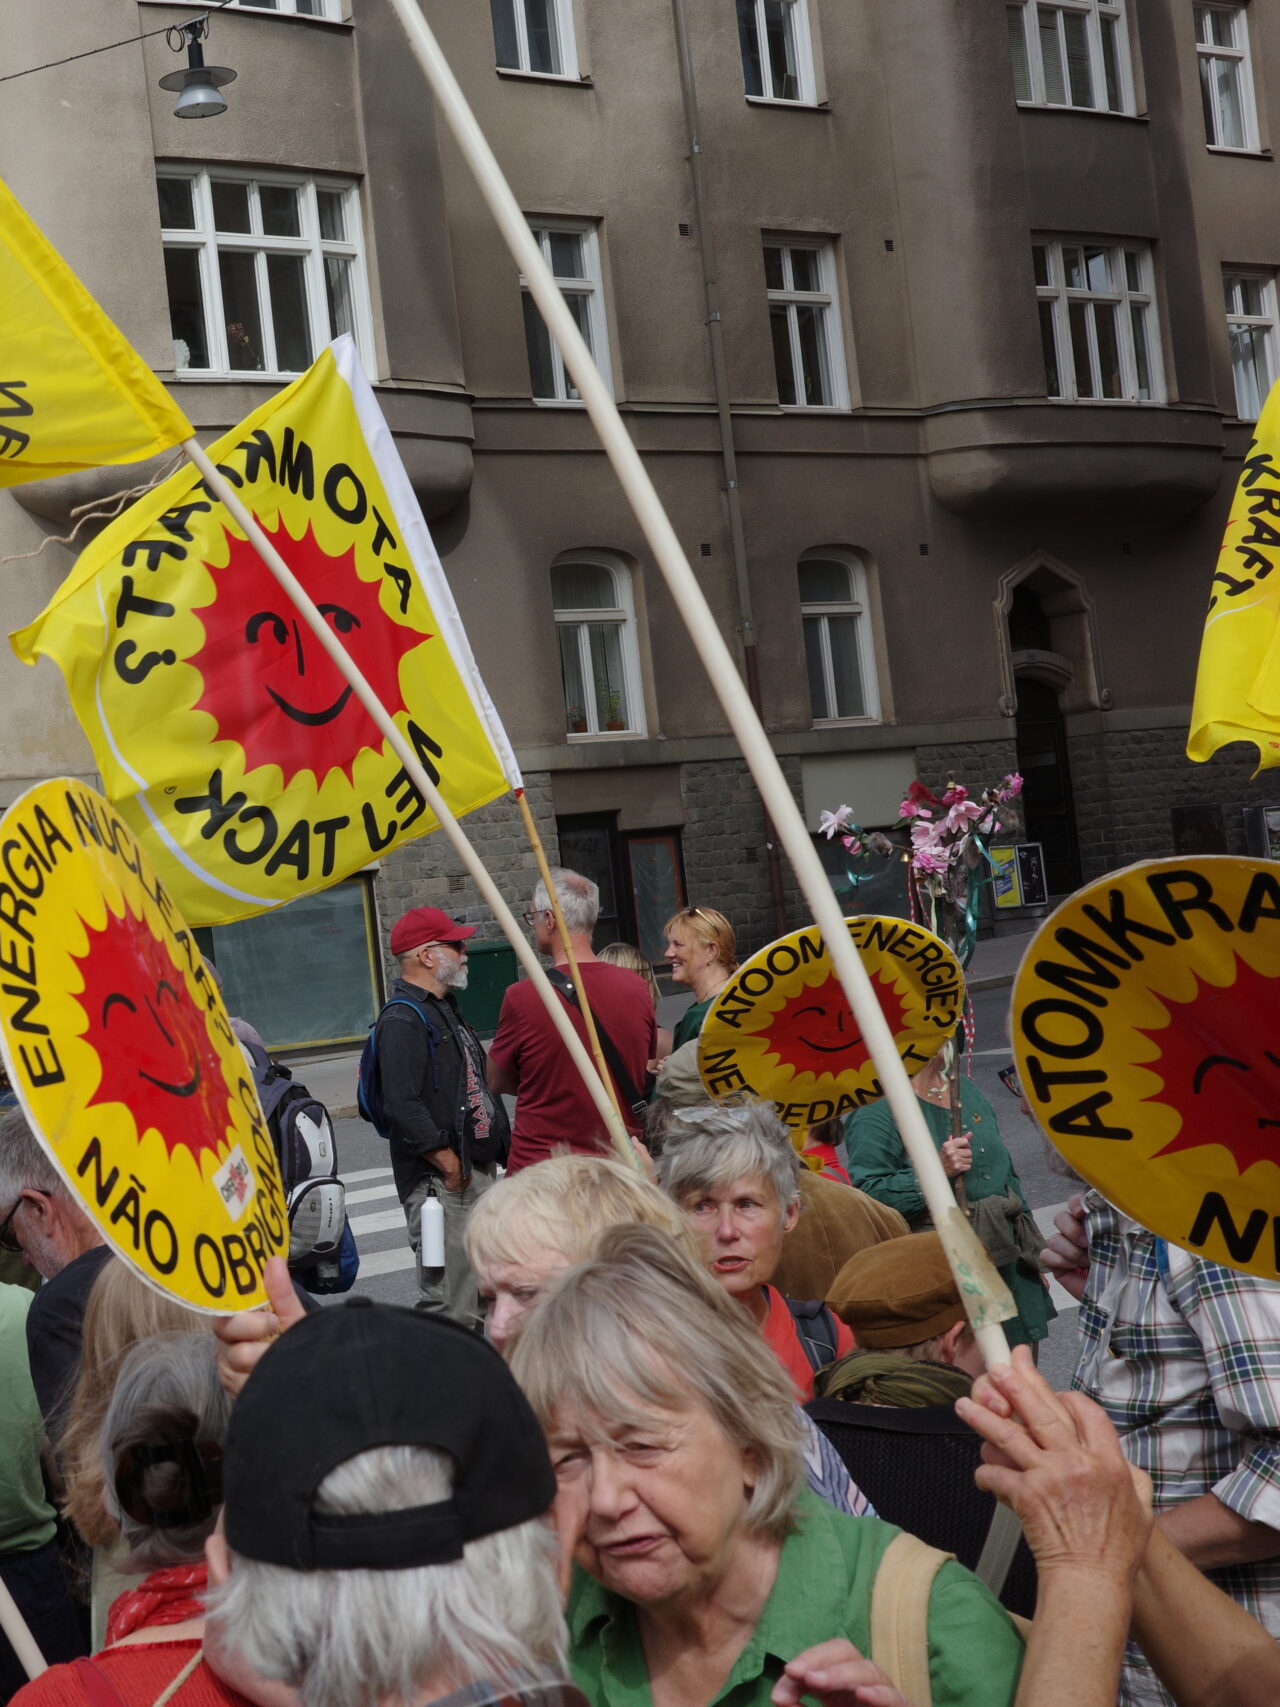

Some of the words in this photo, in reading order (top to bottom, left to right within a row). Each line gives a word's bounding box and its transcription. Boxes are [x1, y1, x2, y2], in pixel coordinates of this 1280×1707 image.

[1207, 439, 1280, 614] KRAFT
[65, 790, 234, 1048] NUCLEAR?
[703, 1048, 760, 1097] NE
[773, 1044, 930, 1129] EDANT
[76, 1136, 179, 1275] NÃO
[194, 1076, 289, 1298] OBRIGADO
